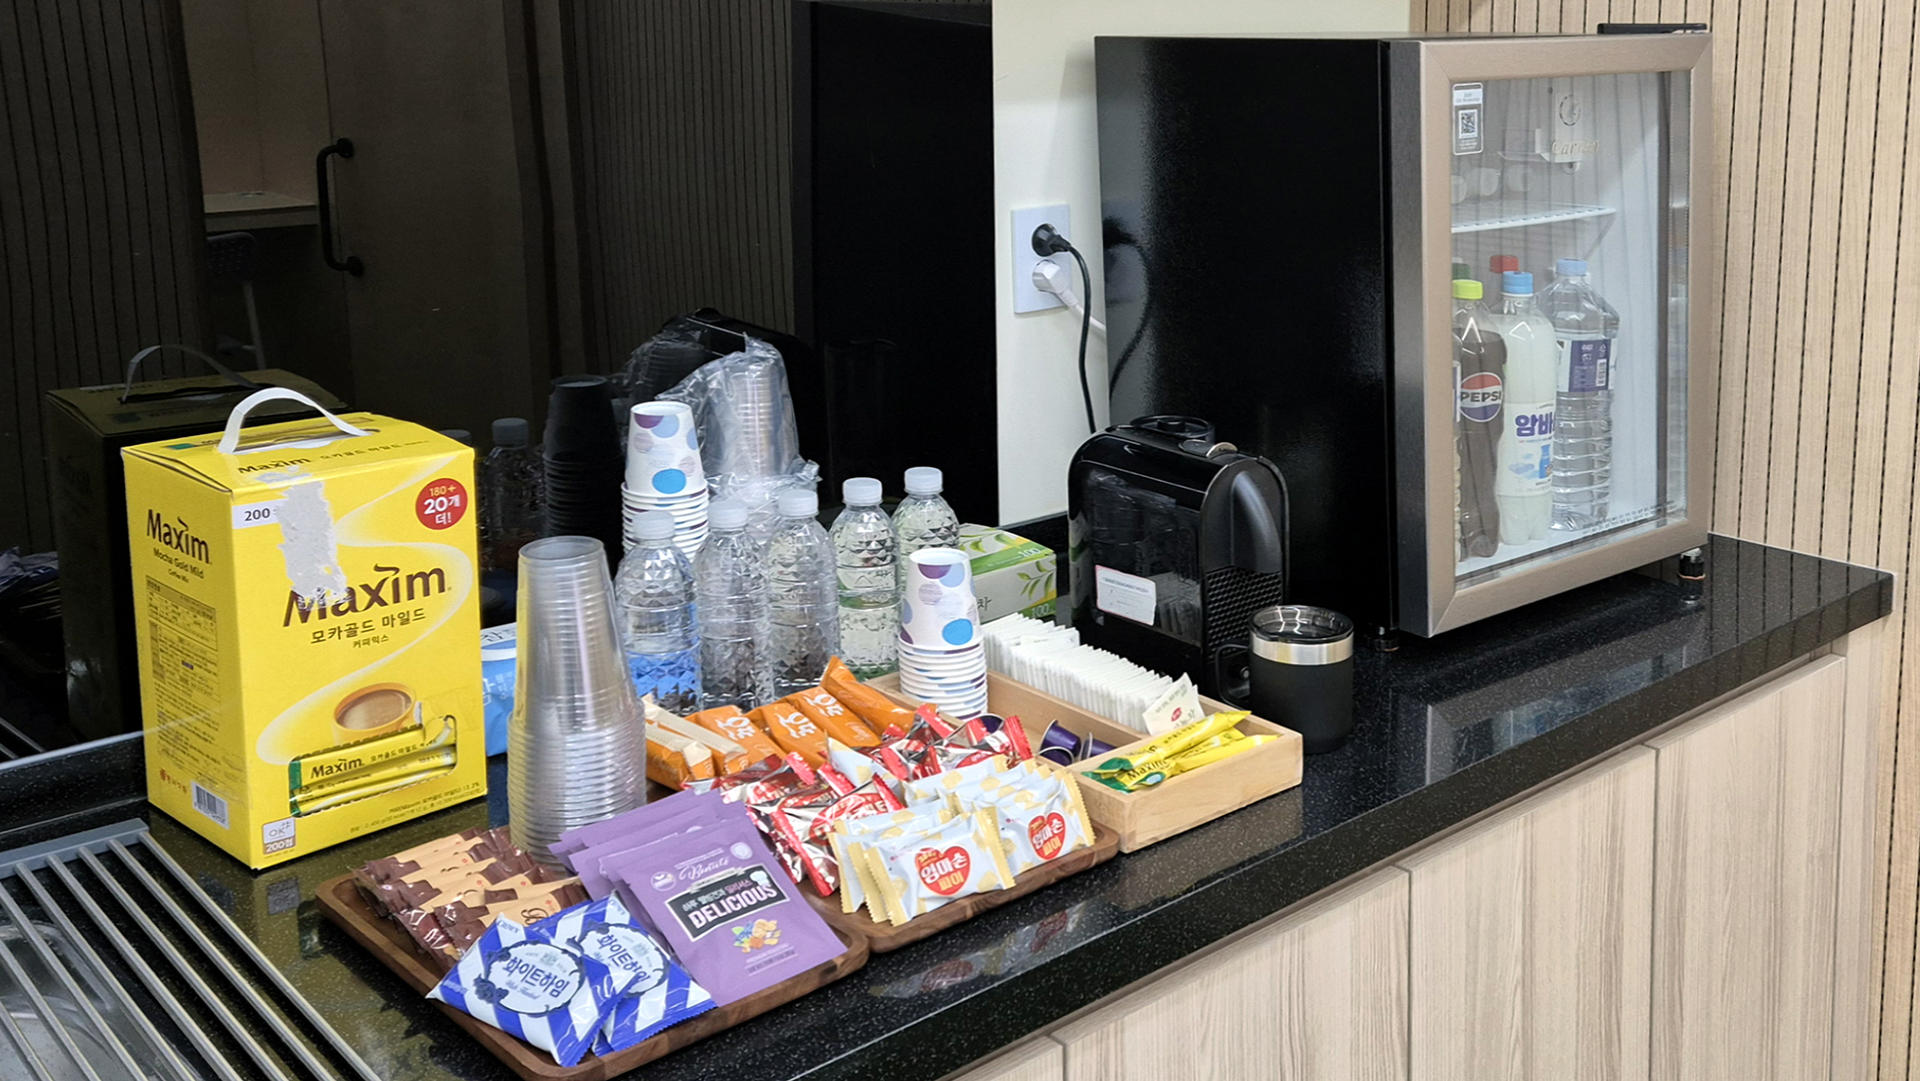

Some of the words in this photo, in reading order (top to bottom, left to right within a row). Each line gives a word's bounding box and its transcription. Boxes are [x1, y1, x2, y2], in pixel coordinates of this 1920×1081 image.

[238, 458, 312, 474] Maxim
[244, 507, 271, 522] 200
[423, 494, 461, 515] 20개
[435, 511, 452, 525] 더!
[146, 508, 210, 565] Maxim
[282, 563, 446, 628] Maxim
[310, 619, 376, 645] 모카골드
[381, 607, 427, 629] 마일드
[352, 633, 390, 649] 커피믹스
[310, 756, 363, 780] Maxim
[1032, 817, 1064, 850] 엄마손
[920, 852, 969, 885] 엄마손
[939, 870, 965, 891] 파이
[687, 883, 778, 929] DELICIOUS
[502, 956, 570, 998] 화이트하임
